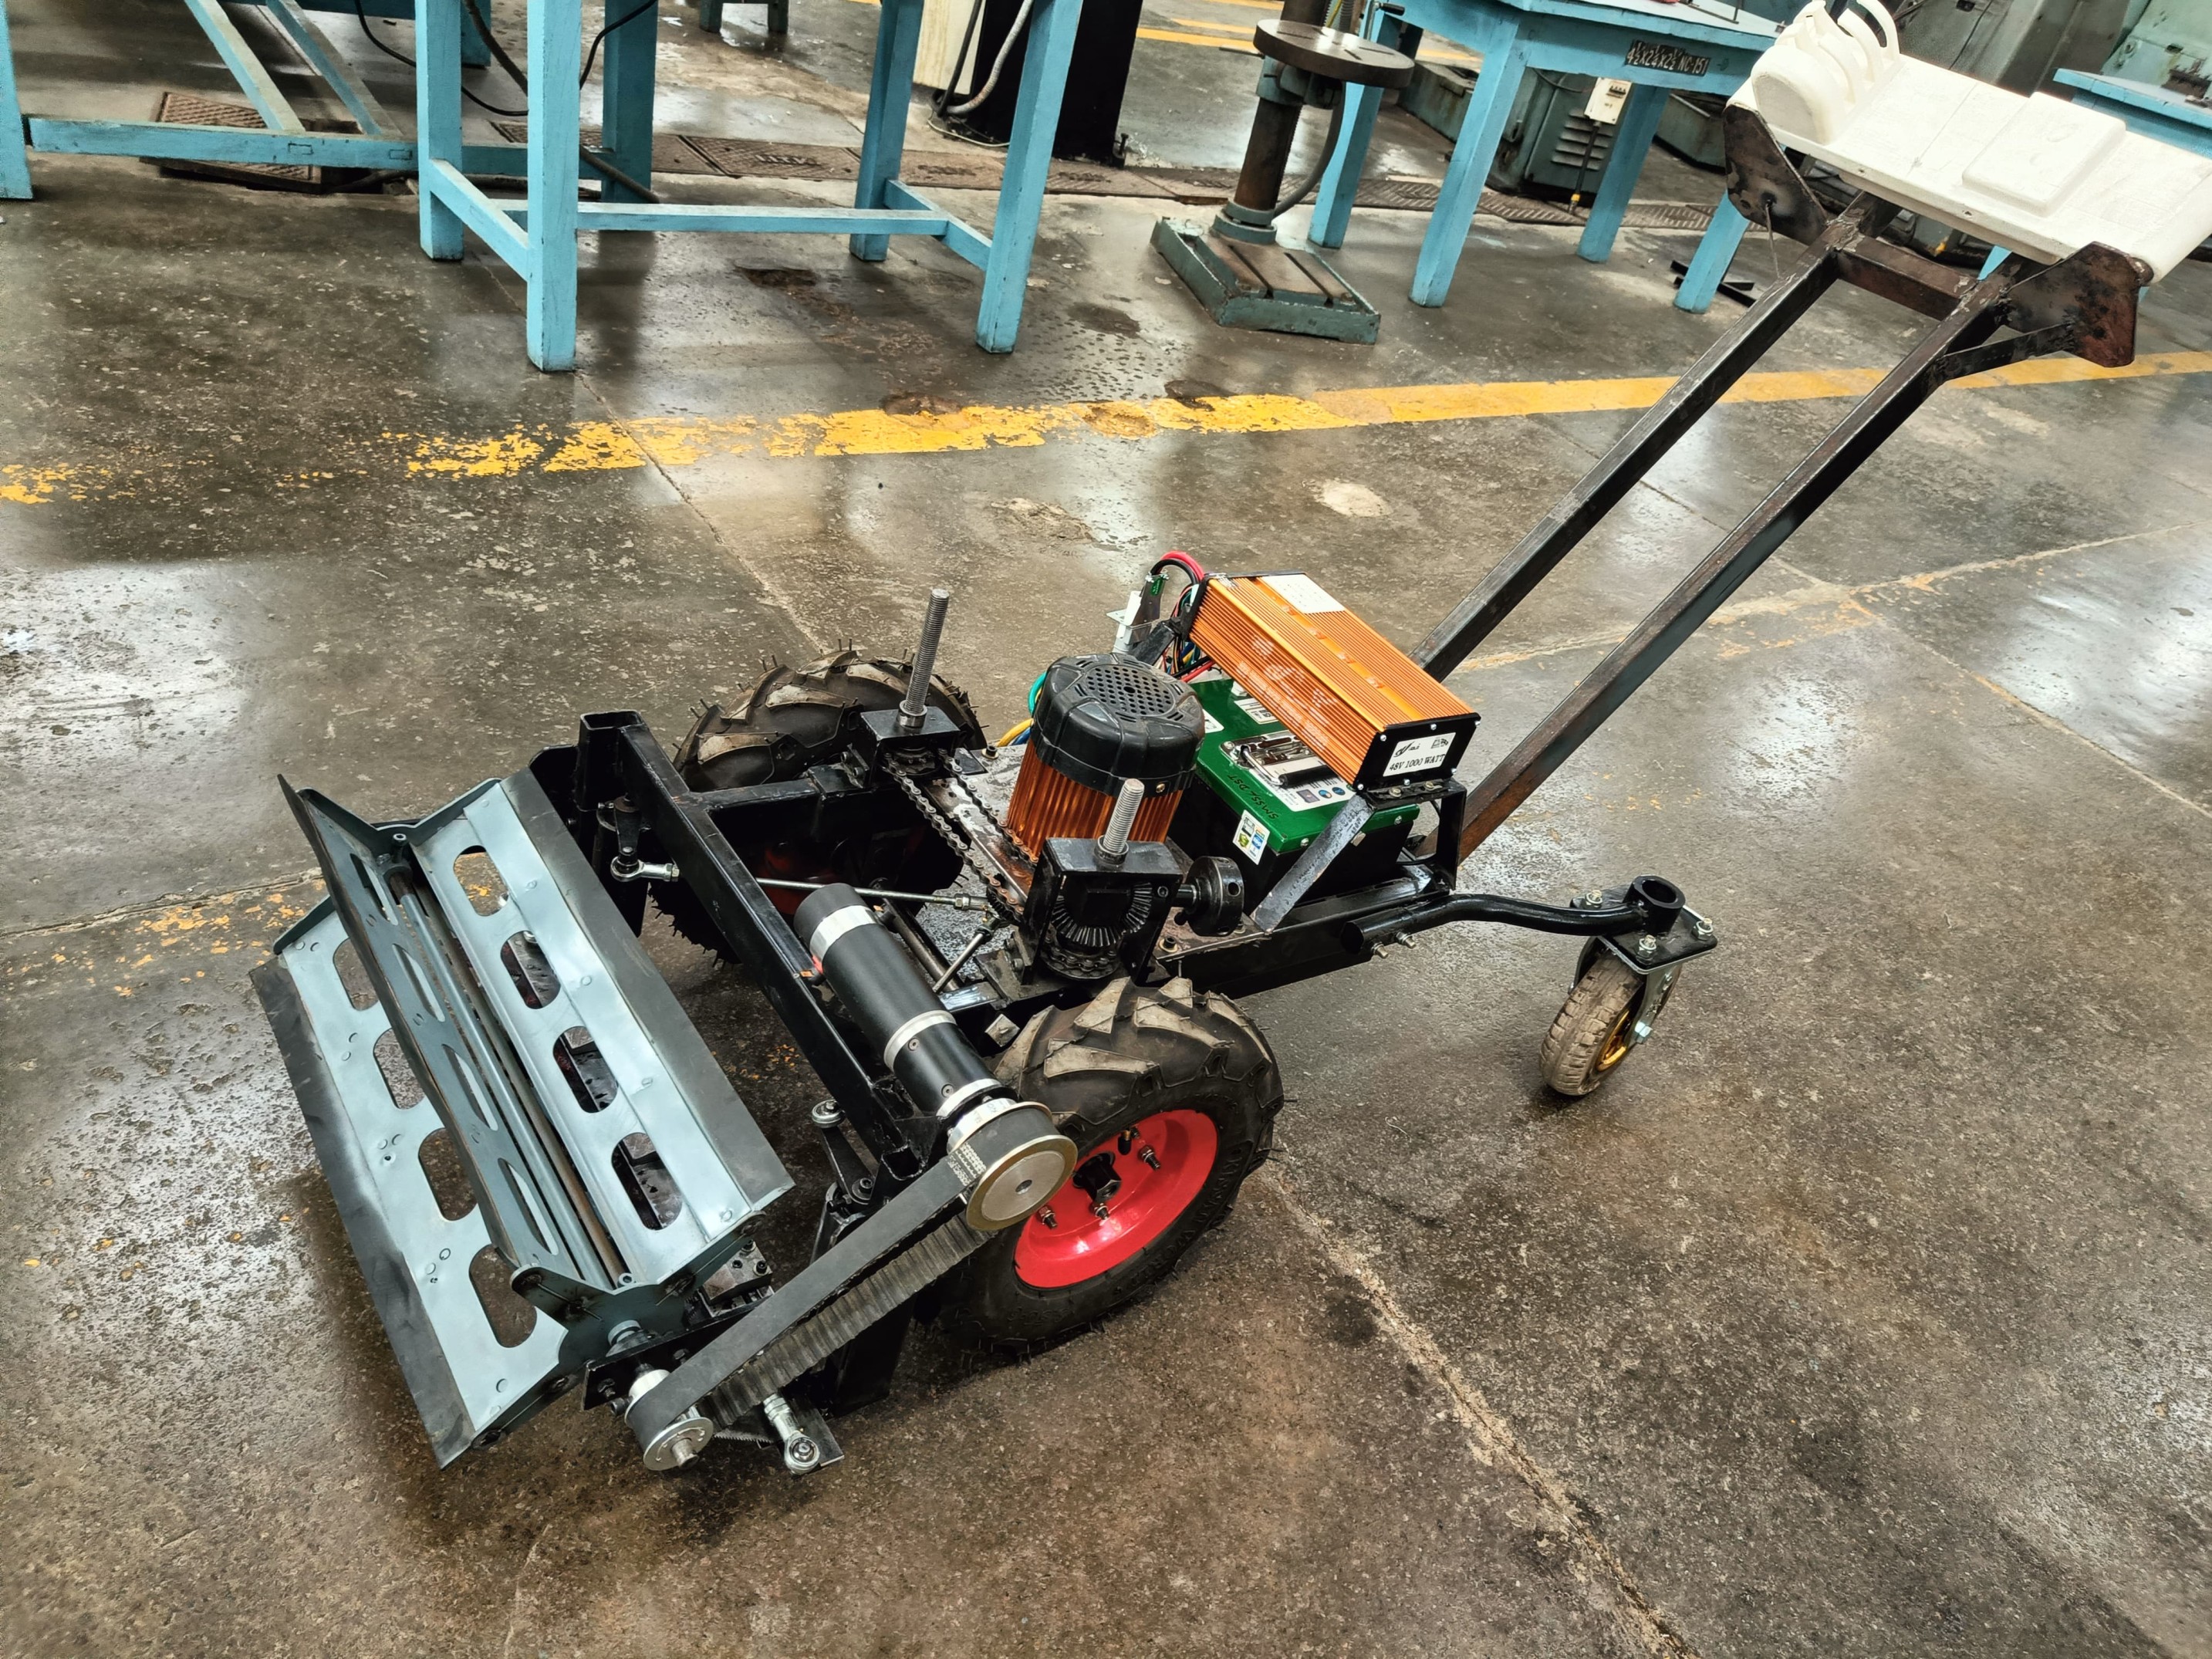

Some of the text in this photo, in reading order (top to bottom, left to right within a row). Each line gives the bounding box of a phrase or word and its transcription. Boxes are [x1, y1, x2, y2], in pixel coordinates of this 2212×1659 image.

[1677, 55, 1709, 75] NC-151
[1389, 753, 1447, 771] 48V 1000 WATT
[1227, 774, 1251, 791] DST
